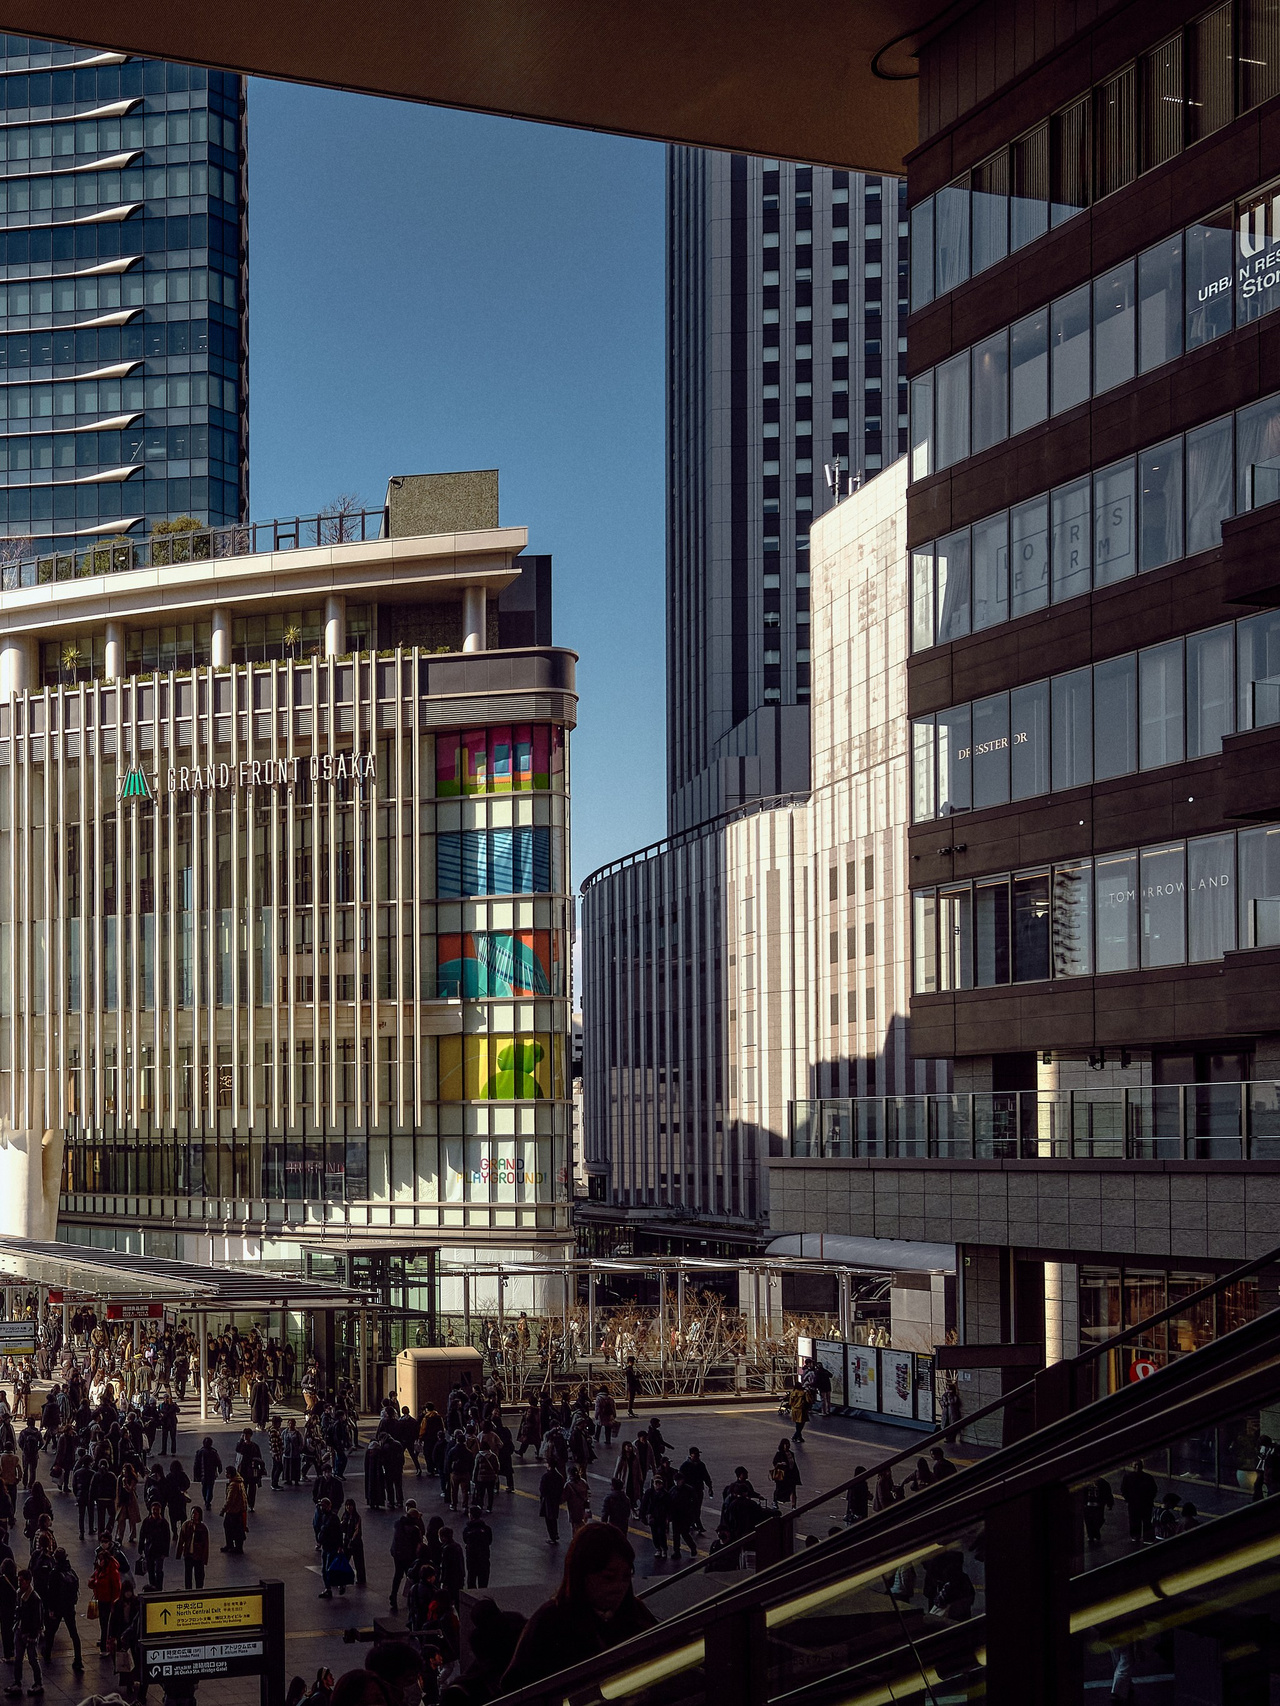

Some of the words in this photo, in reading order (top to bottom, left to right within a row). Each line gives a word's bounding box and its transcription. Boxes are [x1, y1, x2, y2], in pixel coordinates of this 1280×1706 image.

[1003, 507, 1123, 570] LORS
[958, 732, 1028, 760] DRESSTEROR
[167, 763, 229, 792] GRAND
[239, 757, 300, 786] FRONT
[310, 751, 376, 781] OSAKA
[1109, 874, 1229, 904] TOMRROWLAND
[480, 1158, 525, 1170] GRAND
[457, 1171, 547, 1184] PLAYGROUND!
[176, 1602, 203, 1610] 中央北口
[224, 1643, 256, 1651] アトリウム広場
